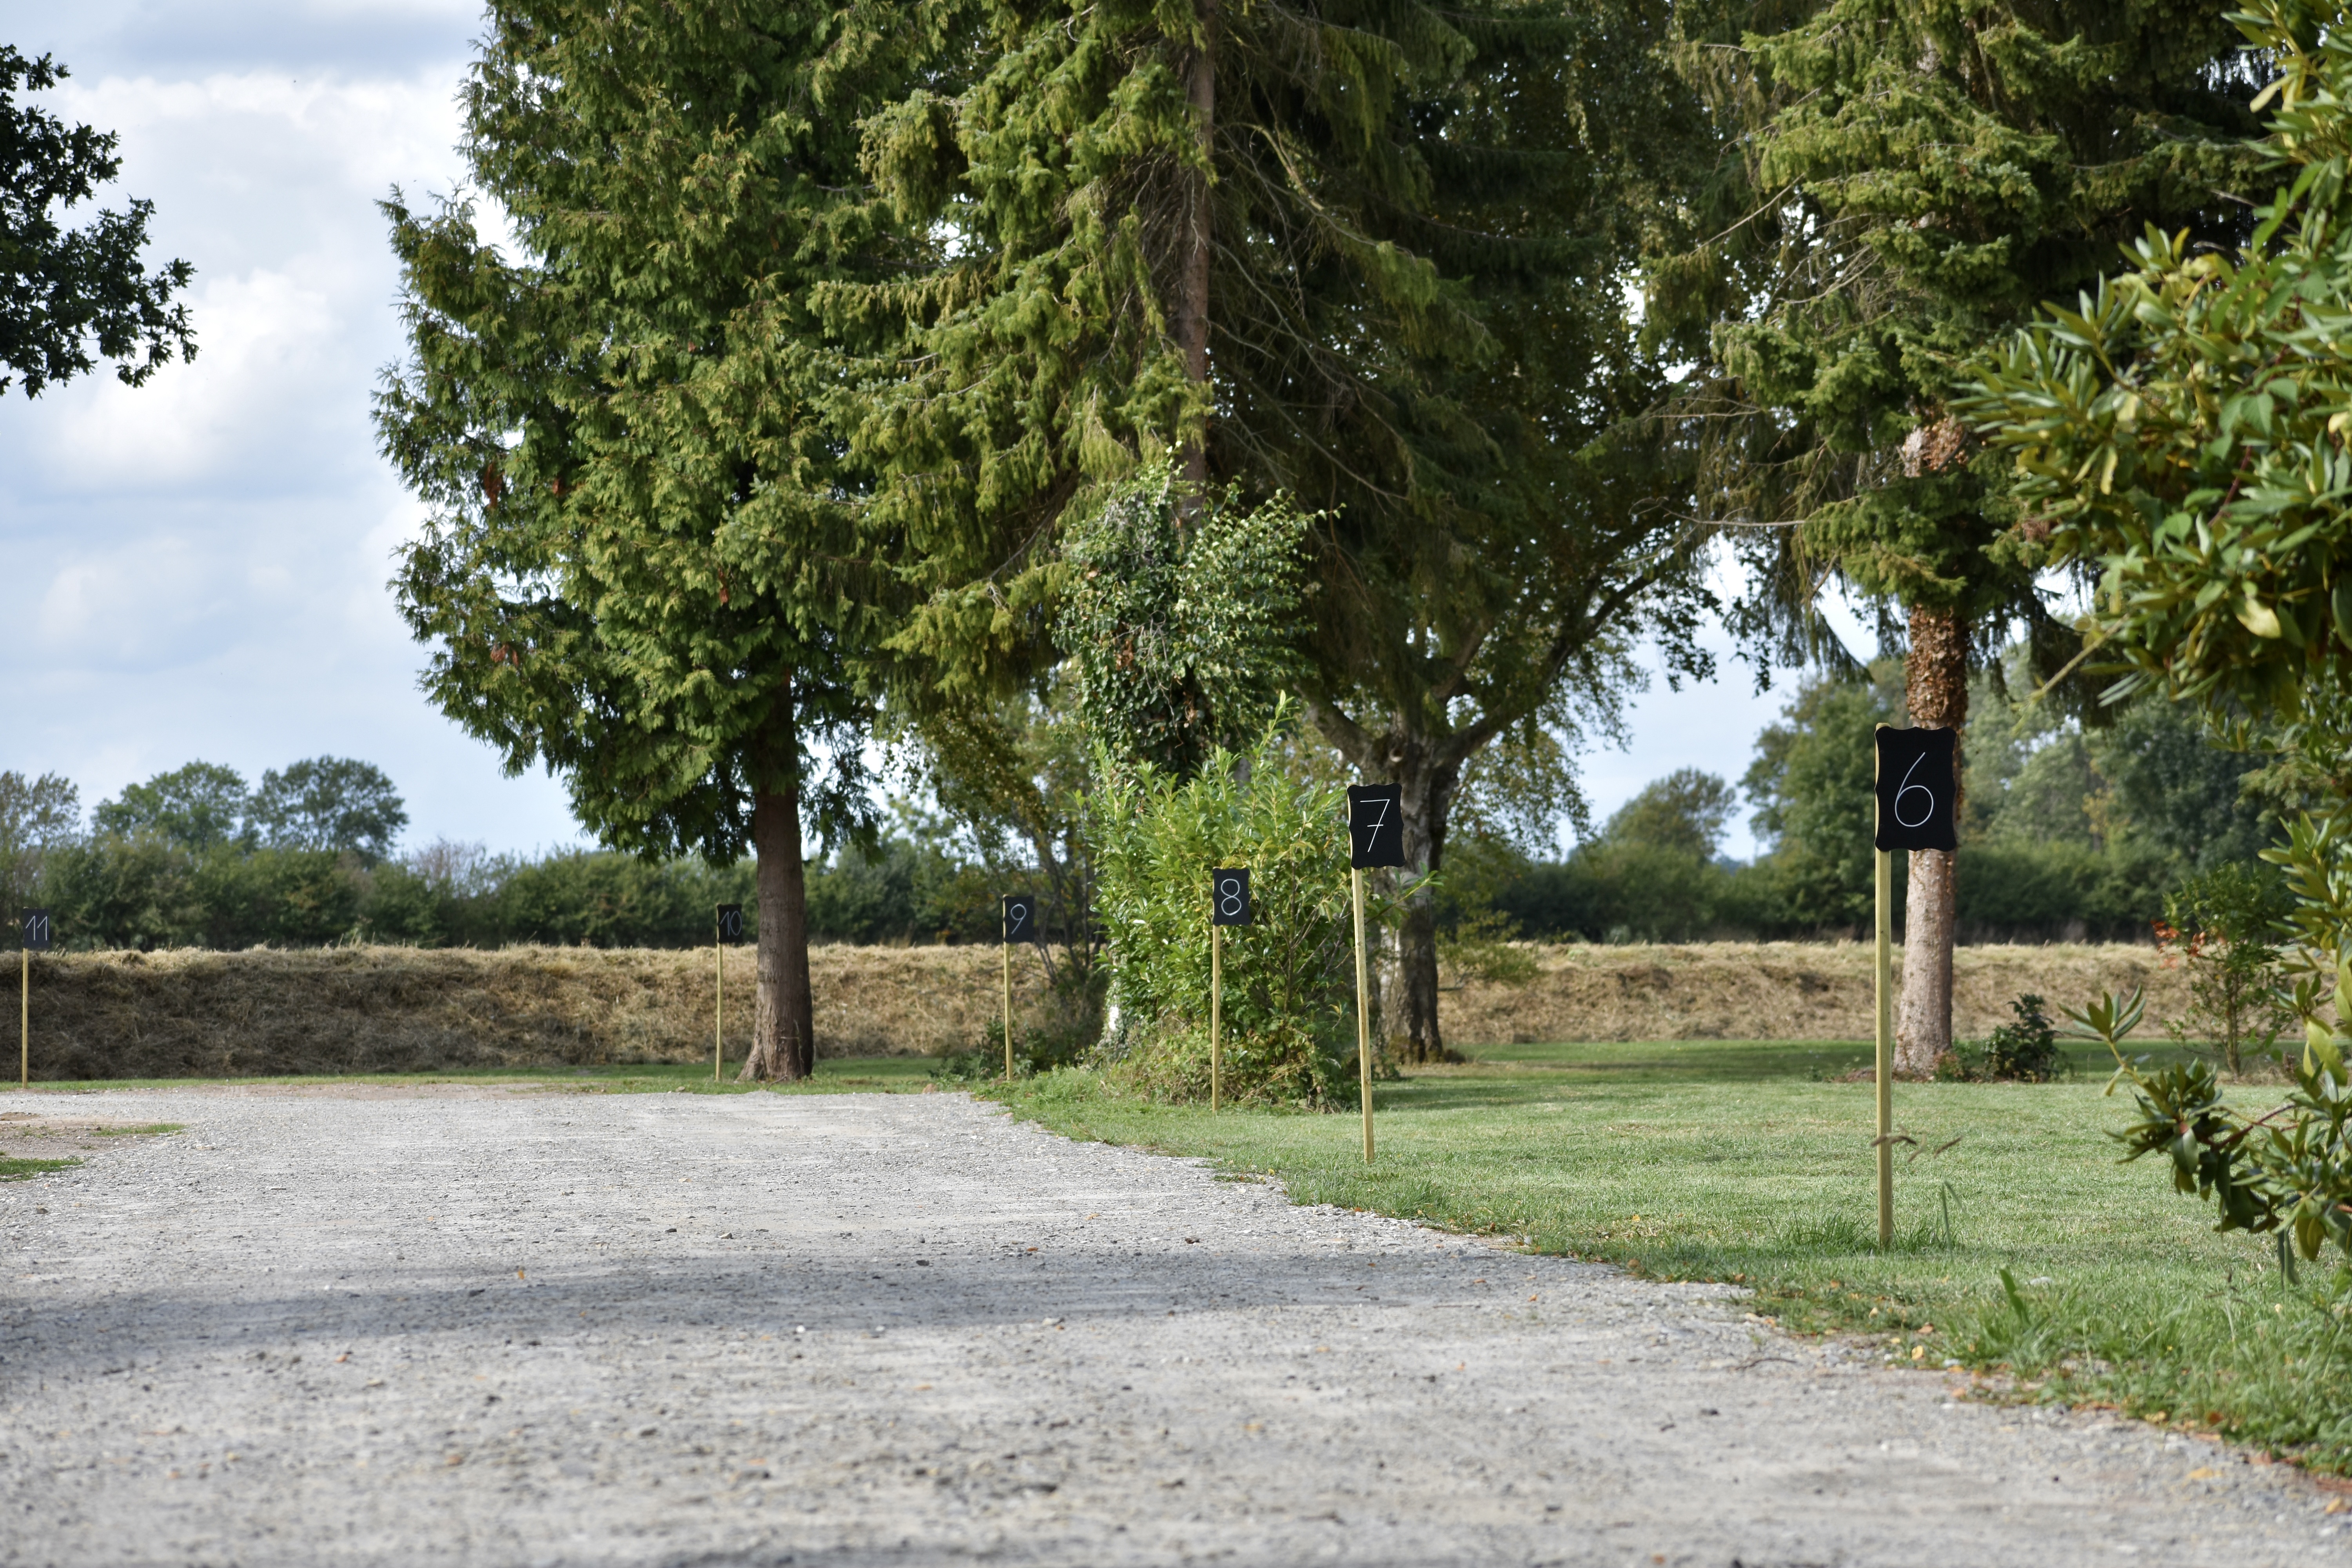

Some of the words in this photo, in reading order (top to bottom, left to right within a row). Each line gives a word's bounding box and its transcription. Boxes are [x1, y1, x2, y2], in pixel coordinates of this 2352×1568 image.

[1895, 752, 1934, 827] 6
[1360, 799, 1390, 853] 7
[1220, 878, 1241, 916] 8
[25, 915, 47, 941] 11
[720, 911, 742, 936] 10
[1010, 903, 1027, 934] 9
